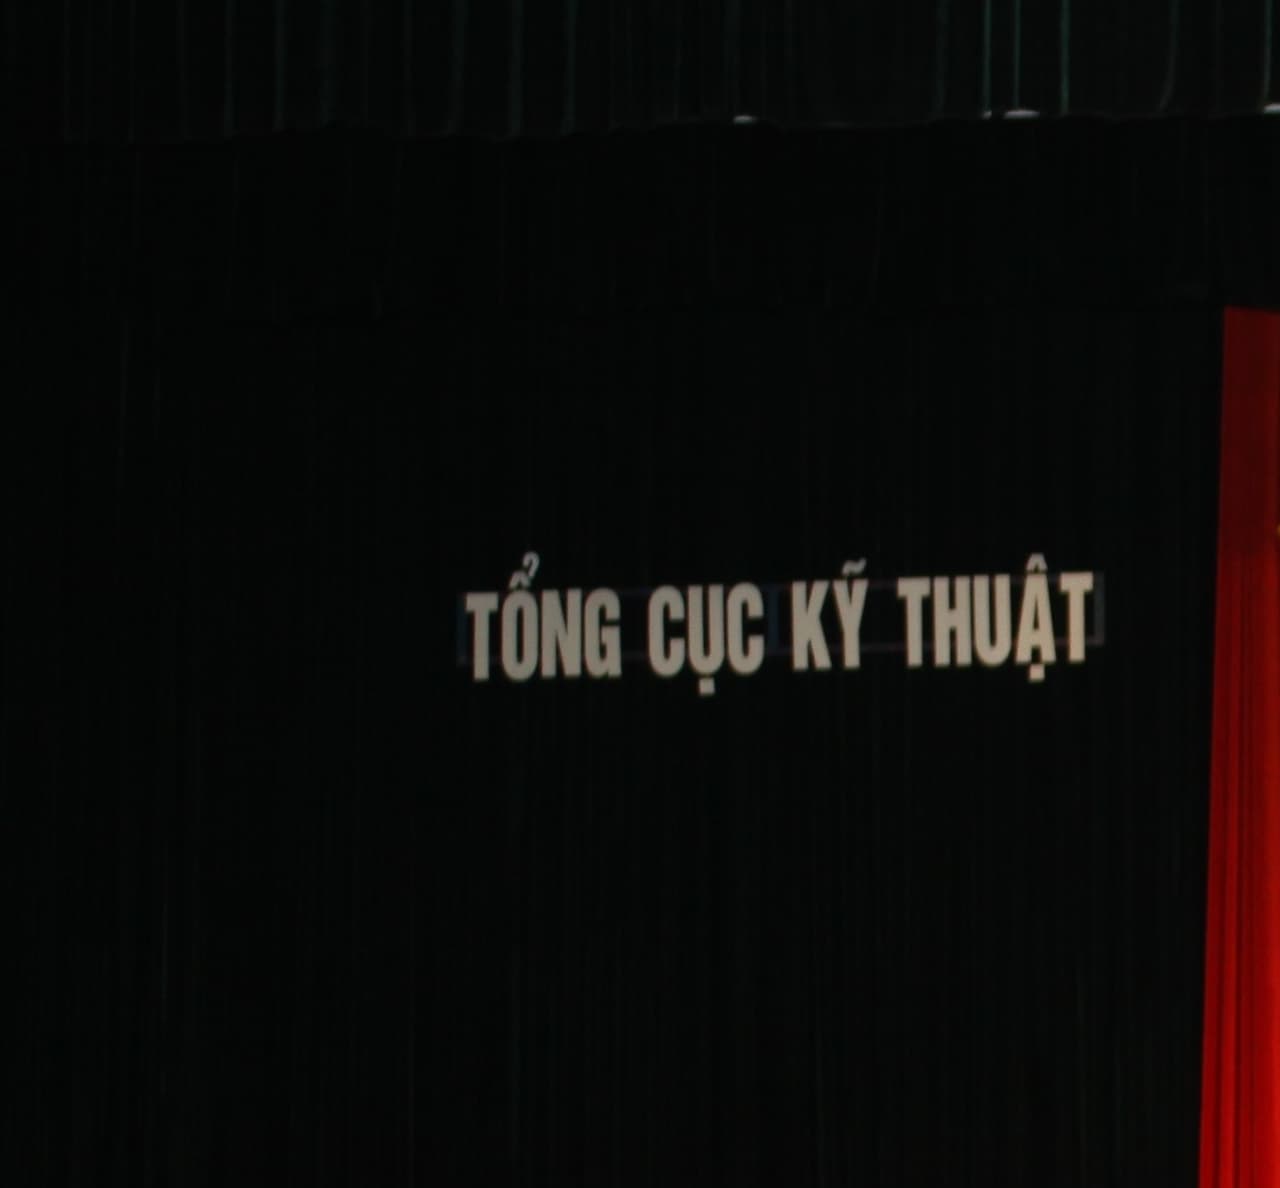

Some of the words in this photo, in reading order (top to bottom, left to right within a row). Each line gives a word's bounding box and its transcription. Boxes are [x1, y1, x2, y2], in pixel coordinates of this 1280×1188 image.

[466, 552, 622, 681] TỔNG
[647, 582, 765, 695] CỤC
[791, 558, 868, 671] KỸ
[897, 553, 1094, 682] THUẬT
